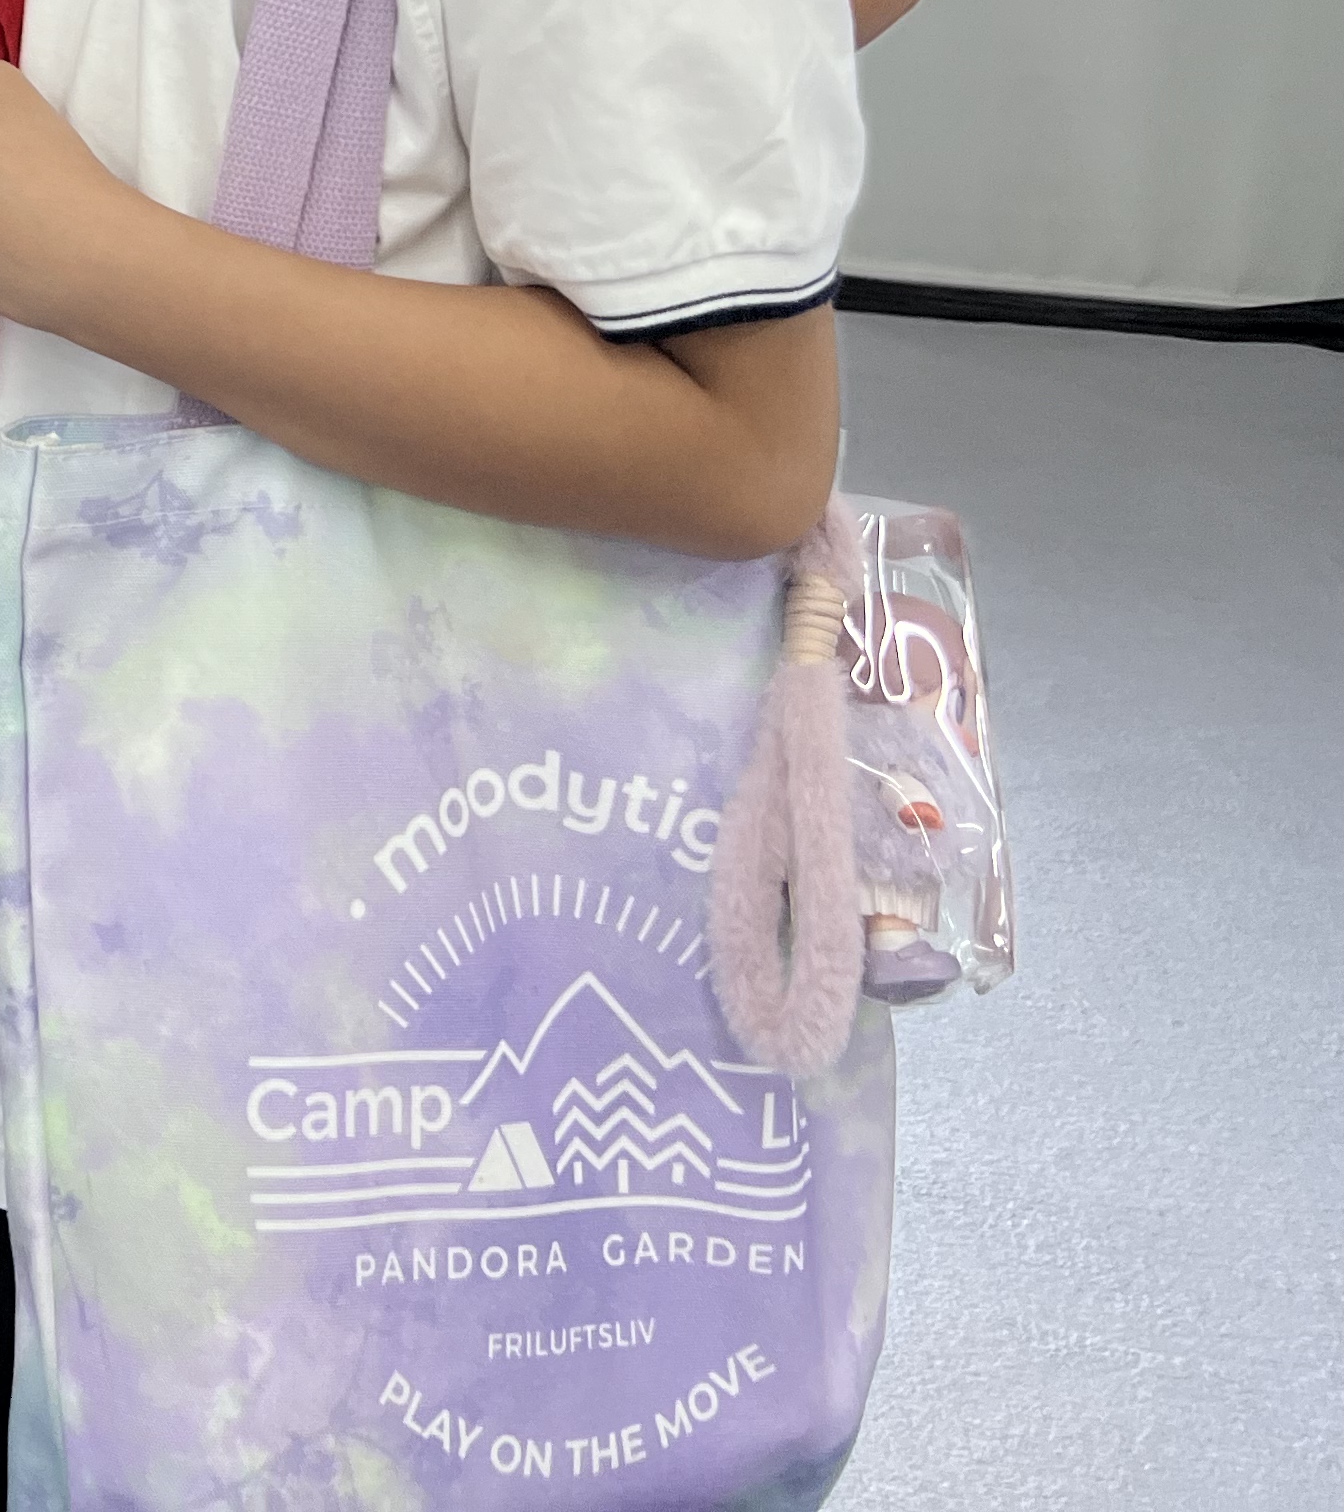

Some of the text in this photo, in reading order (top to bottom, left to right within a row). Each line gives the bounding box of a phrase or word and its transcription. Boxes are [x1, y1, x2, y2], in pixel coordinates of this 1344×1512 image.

[247, 1078, 453, 1151] Camp
[355, 1232, 805, 1287] PANDORA GARDEN
[488, 1317, 656, 1360] FRILUFTSLIV
[379, 1343, 778, 1478] PLAY ON THE MOVE
